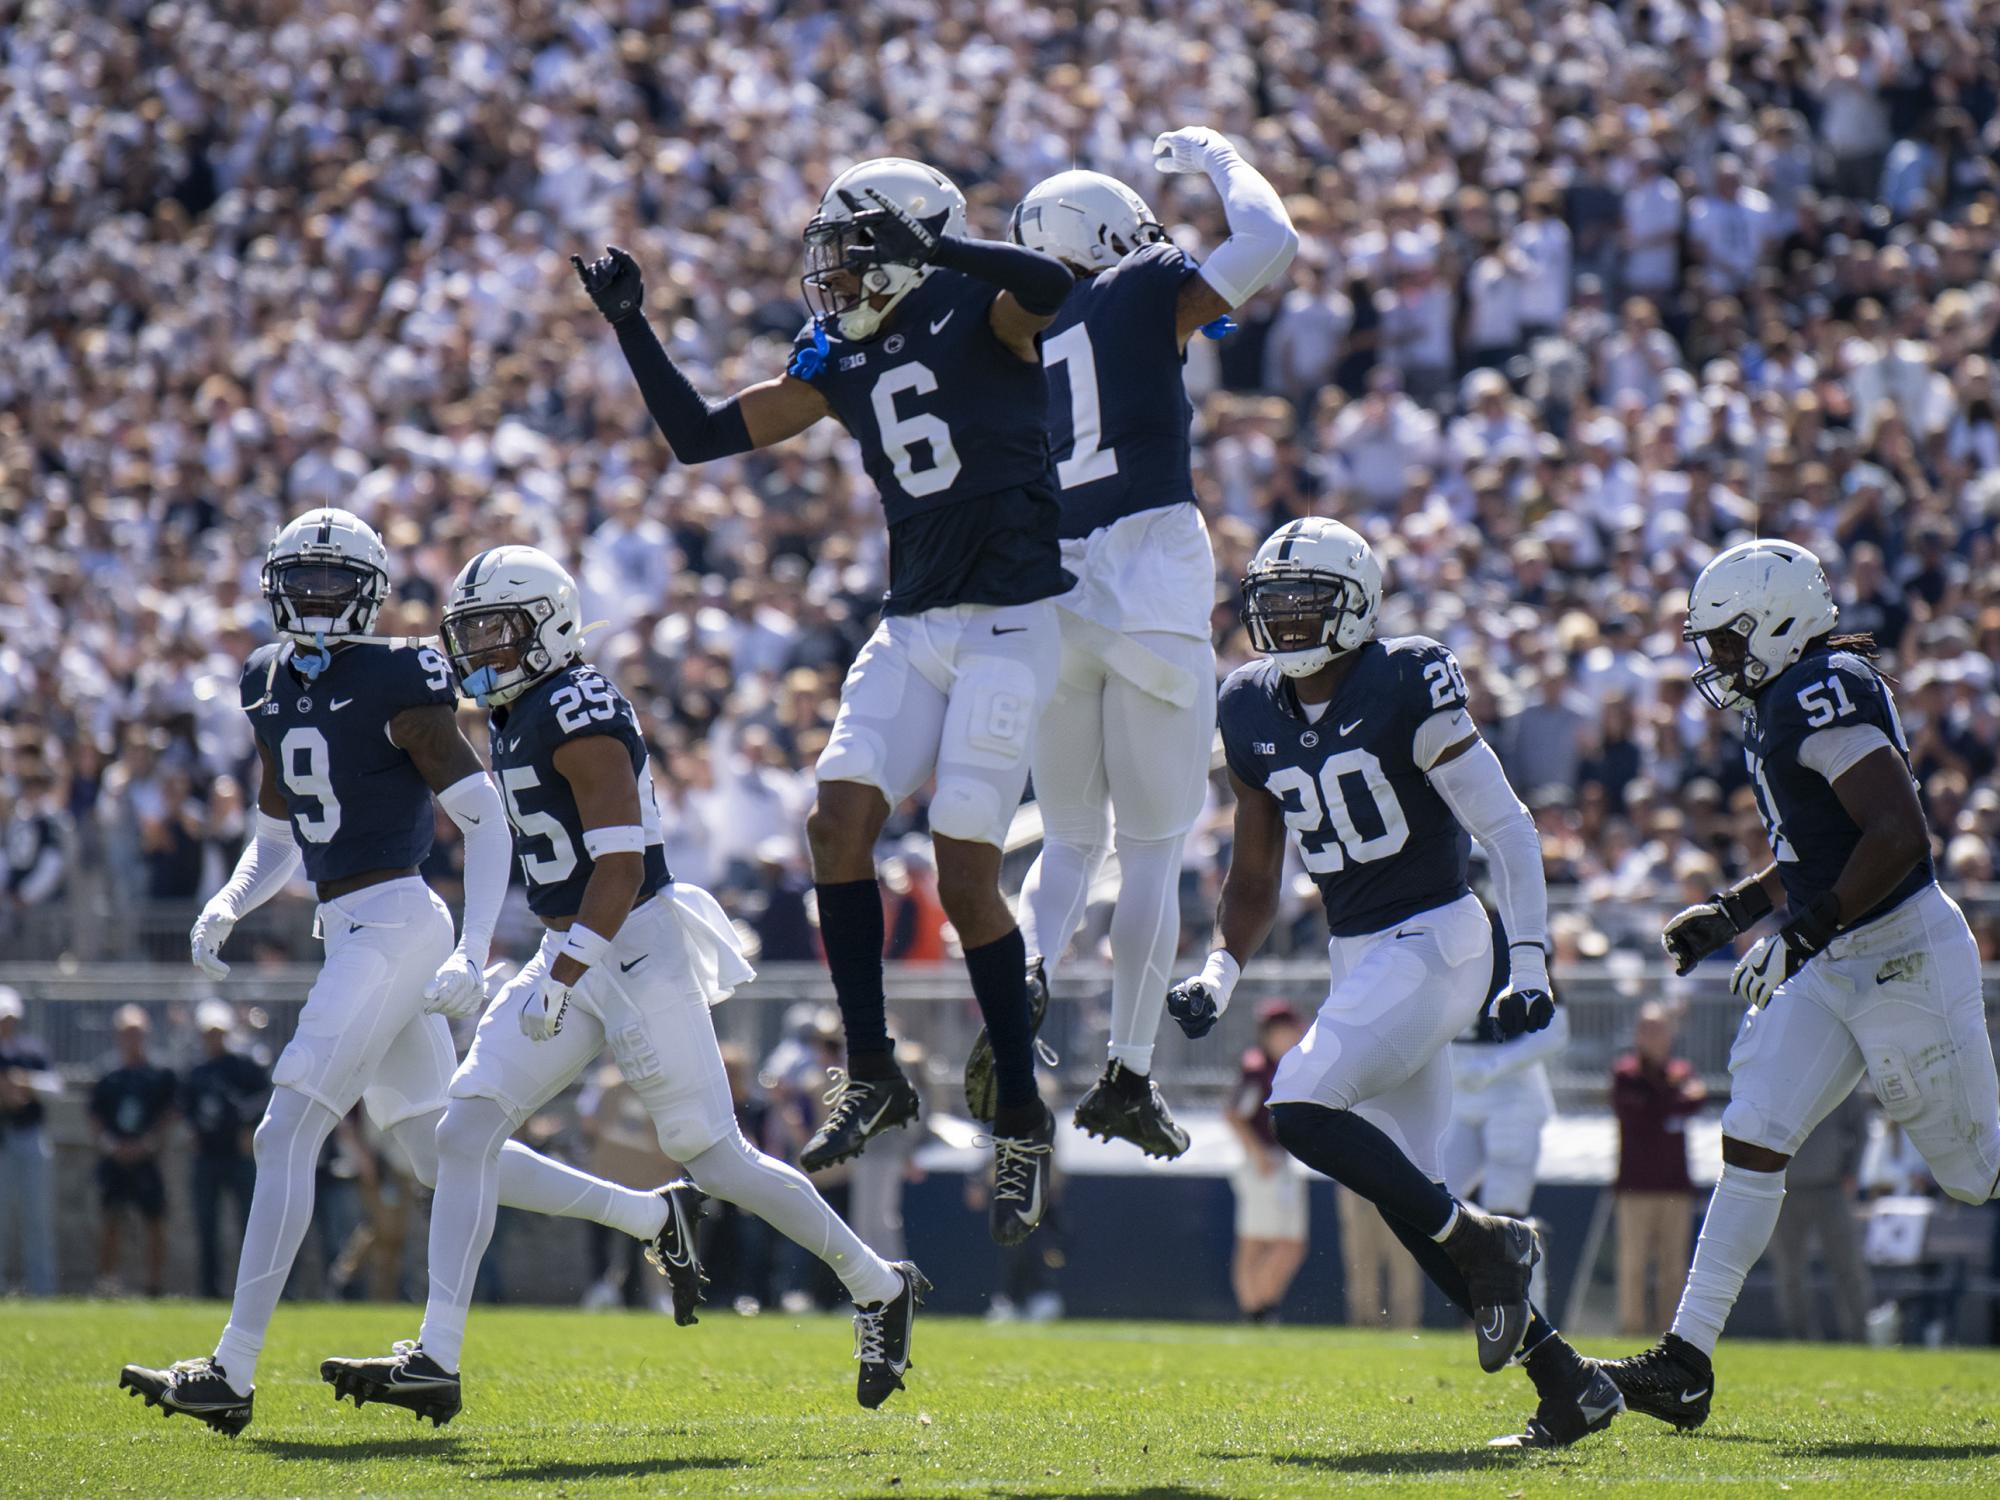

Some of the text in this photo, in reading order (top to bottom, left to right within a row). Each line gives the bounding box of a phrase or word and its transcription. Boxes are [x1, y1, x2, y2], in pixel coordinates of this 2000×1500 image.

[871, 361, 963, 497] 6
[1042, 321, 1118, 489] 1
[417, 650, 447, 690] 9
[550, 679, 616, 734] 25
[1424, 654, 1470, 709] 20
[1797, 675, 1856, 728] 51
[281, 727, 341, 842] 9
[1264, 747, 1410, 873] 20
